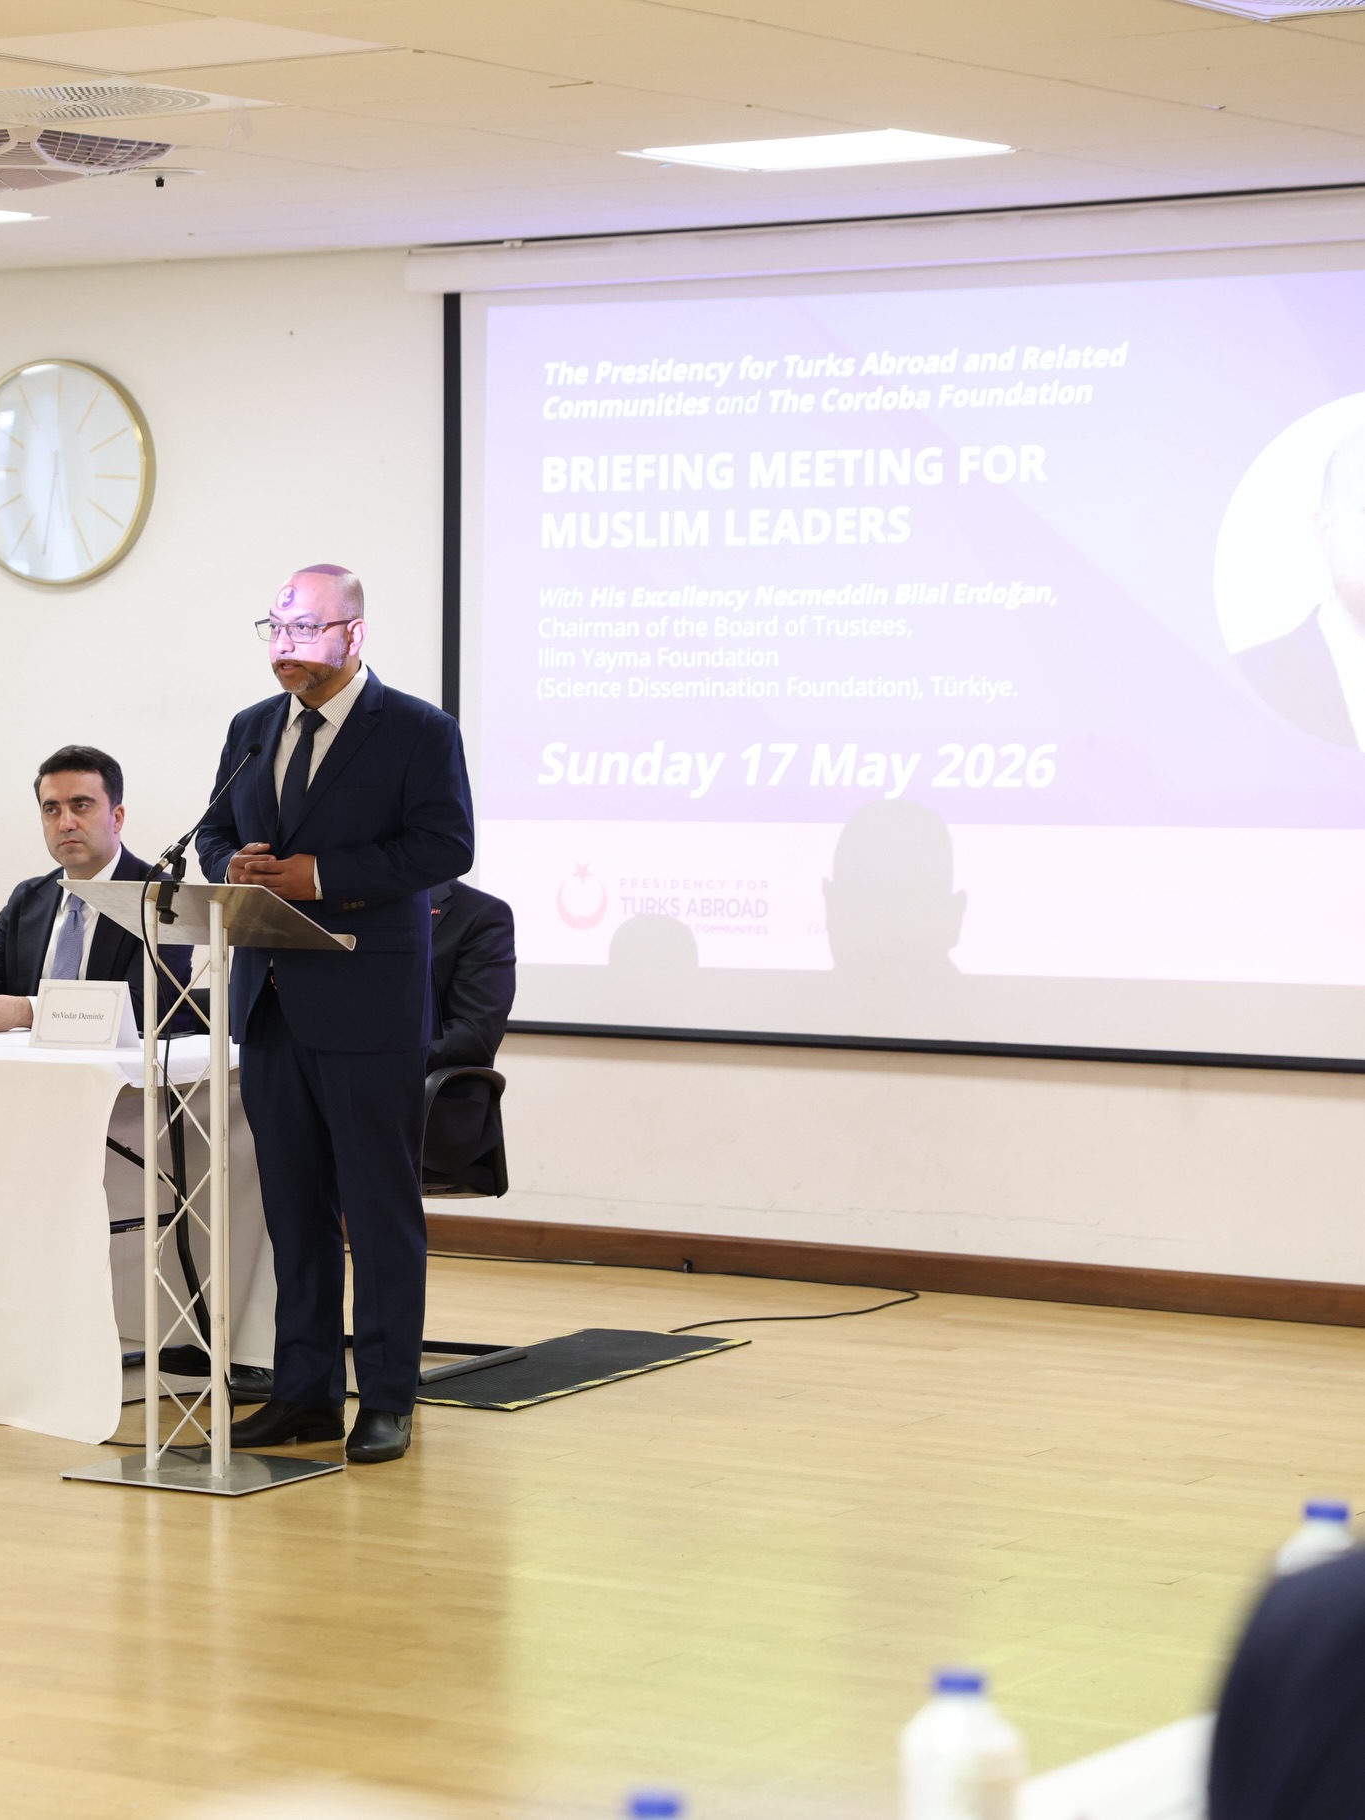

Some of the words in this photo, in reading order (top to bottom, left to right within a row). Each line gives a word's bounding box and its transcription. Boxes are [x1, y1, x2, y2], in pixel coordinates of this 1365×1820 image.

[544, 361, 589, 385] The
[595, 358, 734, 387] Presidency
[739, 355, 778, 380] for
[784, 352, 855, 378] Turks
[860, 348, 958, 376] Abroad
[963, 346, 1016, 372] and
[1022, 341, 1129, 370] Related
[543, 392, 710, 420] Communities
[715, 390, 761, 415] and
[769, 388, 815, 413] The
[821, 385, 931, 412] Cordoba
[938, 381, 1093, 408] Foundation
[543, 452, 734, 492] BRIEFING
[750, 447, 943, 488] MEETING
[959, 445, 1047, 484] FOR
[542, 510, 709, 548] MUSLIM
[725, 506, 910, 546] LEADERS
[540, 587, 583, 608] With
[591, 586, 626, 607] His
[632, 586, 750, 612] Excellency
[755, 584, 888, 606] Necmeddin
[895, 583, 948, 604] Bilal
[953, 581, 1057, 609] Erdoğan,
[539, 617, 639, 638] Chairman
[646, 616, 668, 637] of
[674, 616, 707, 637] the
[715, 616, 777, 636] Board
[785, 615, 808, 636] of
[813, 616, 912, 638] Trustees,
[582, 648, 650, 672] Yayma
[658, 647, 778, 667] Foundation
[537, 677, 621, 700] (Science
[629, 678, 779, 698] Dissemination
[787, 676, 923, 700] Foundation),
[930, 676, 1018, 703] Türkiye.
[538, 740, 726, 799] Sunday
[741, 743, 798, 786] 17
[810, 744, 922, 800] May
[931, 743, 1057, 788] 2026
[619, 878, 726, 890] PRESIDENCY
[736, 879, 769, 890] FOR
[619, 896, 681, 917] TURKS
[685, 897, 769, 918] ABROAD
[695, 924, 769, 935] COMMUNITIES
